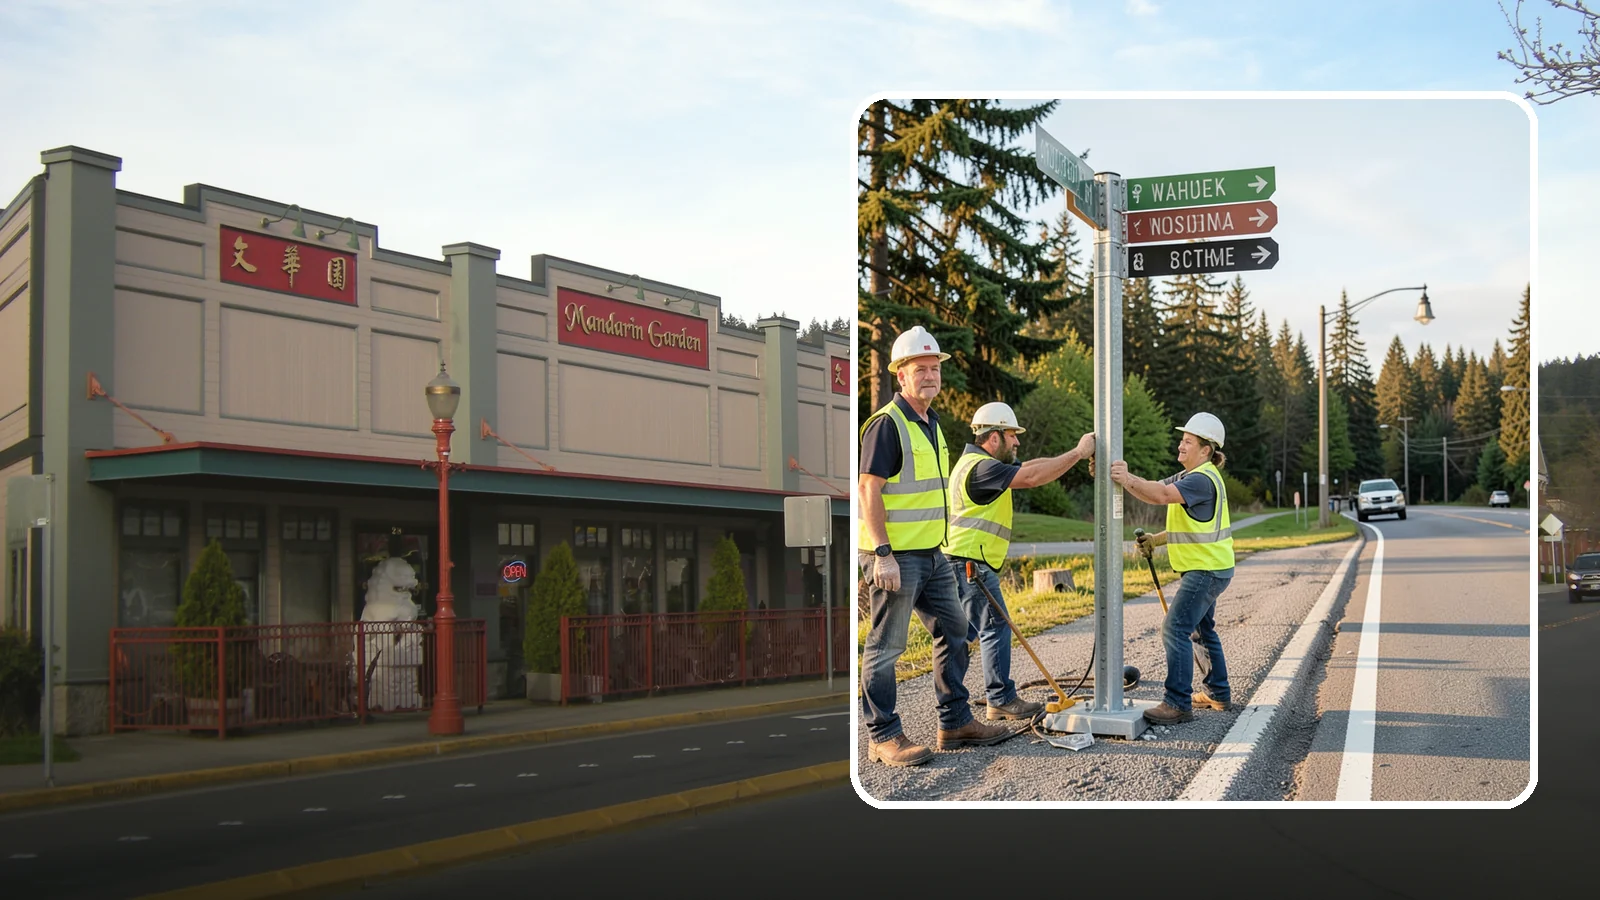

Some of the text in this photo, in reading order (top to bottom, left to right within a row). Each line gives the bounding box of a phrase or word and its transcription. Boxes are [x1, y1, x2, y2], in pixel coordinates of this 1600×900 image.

[230, 235, 347, 291] 文華園
[564, 302, 702, 352] Mandarin Garden
[503, 565, 527, 578] OPEN
